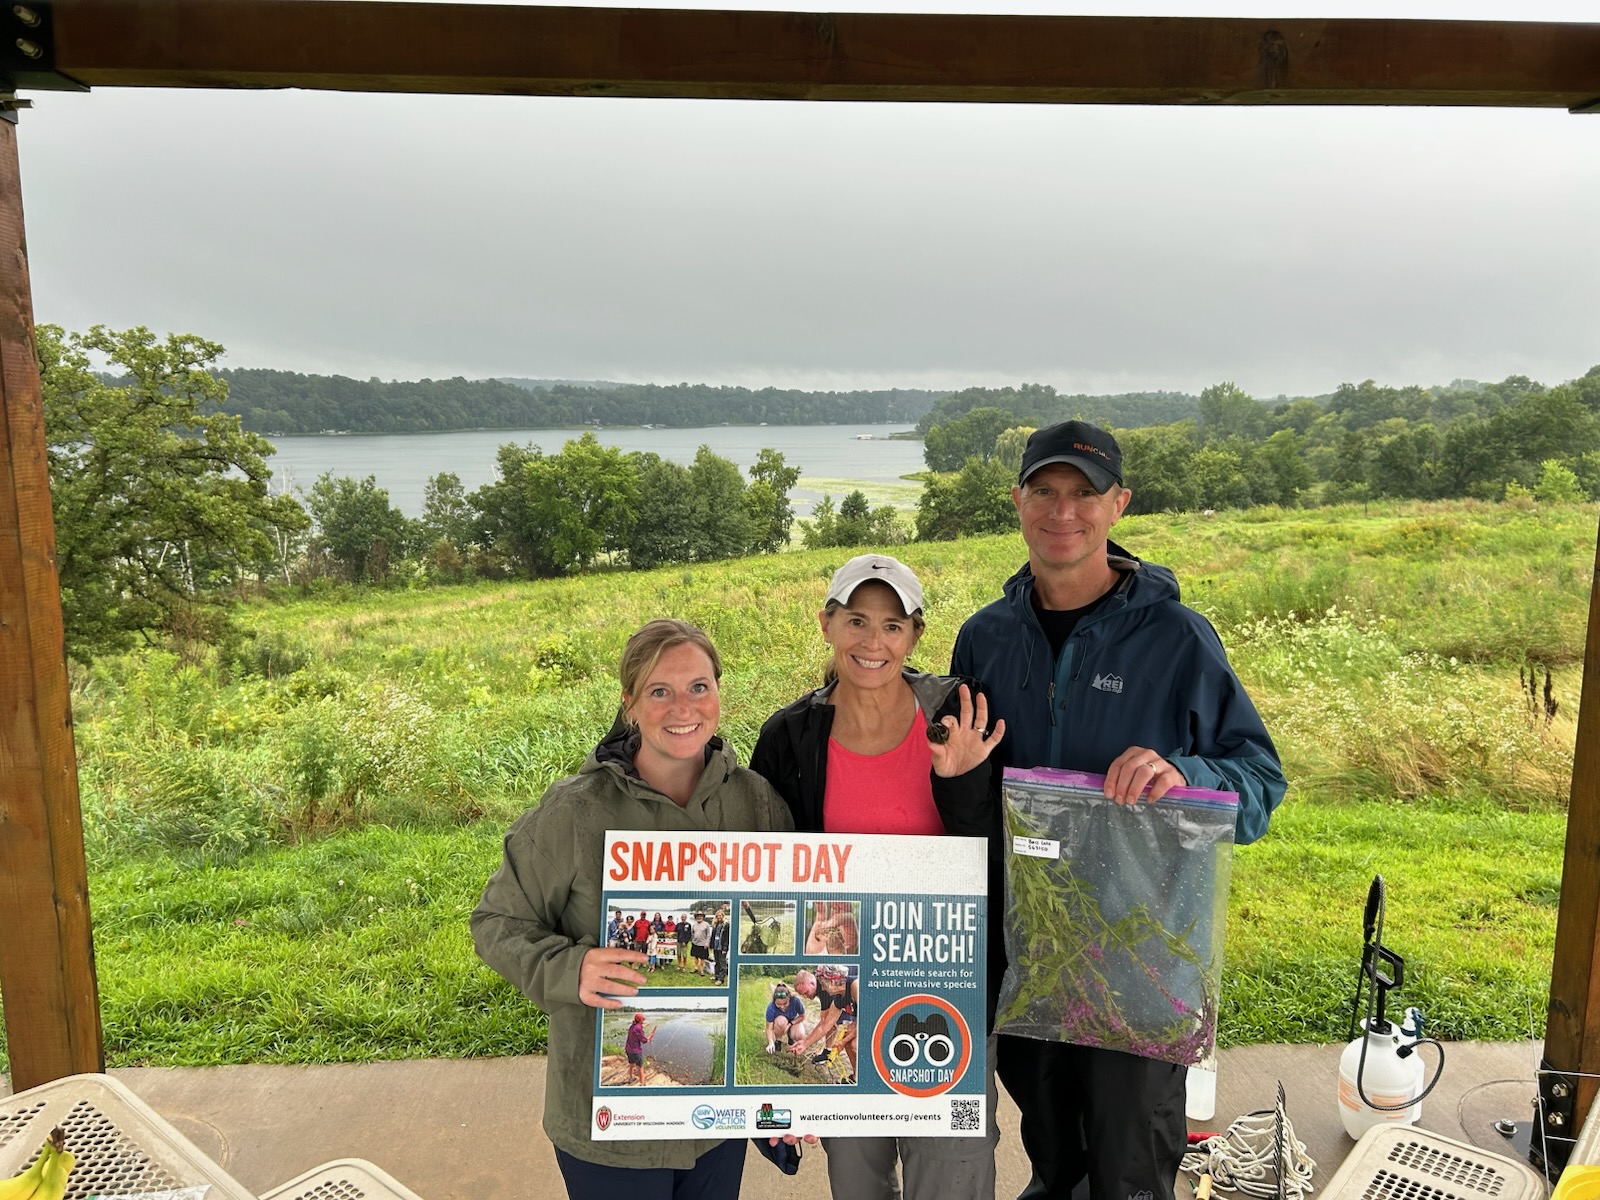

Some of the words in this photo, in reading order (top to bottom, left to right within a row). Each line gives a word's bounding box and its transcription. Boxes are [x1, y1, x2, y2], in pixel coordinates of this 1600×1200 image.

[1103, 680, 1123, 690] REI
[609, 841, 782, 882] SNAPSHOT
[792, 843, 853, 883] DAY
[871, 901, 922, 930] JOIN
[932, 902, 976, 931] THE
[872, 933, 974, 963] SEARCH!
[871, 968, 879, 977] A
[881, 968, 925, 977] statewide
[928, 968, 957, 977] search
[960, 969, 973, 977] for
[867, 979, 901, 989] aquatic
[903, 979, 941, 988] invasive
[943, 980, 977, 989] species
[889, 1068, 935, 1083] SNAPSHOT
[938, 1069, 954, 1083] DAY
[716, 1109, 746, 1117] WATER
[800, 1111, 942, 1122] wateractionvolunteers.org/events
[716, 1117, 746, 1125] ACTION
